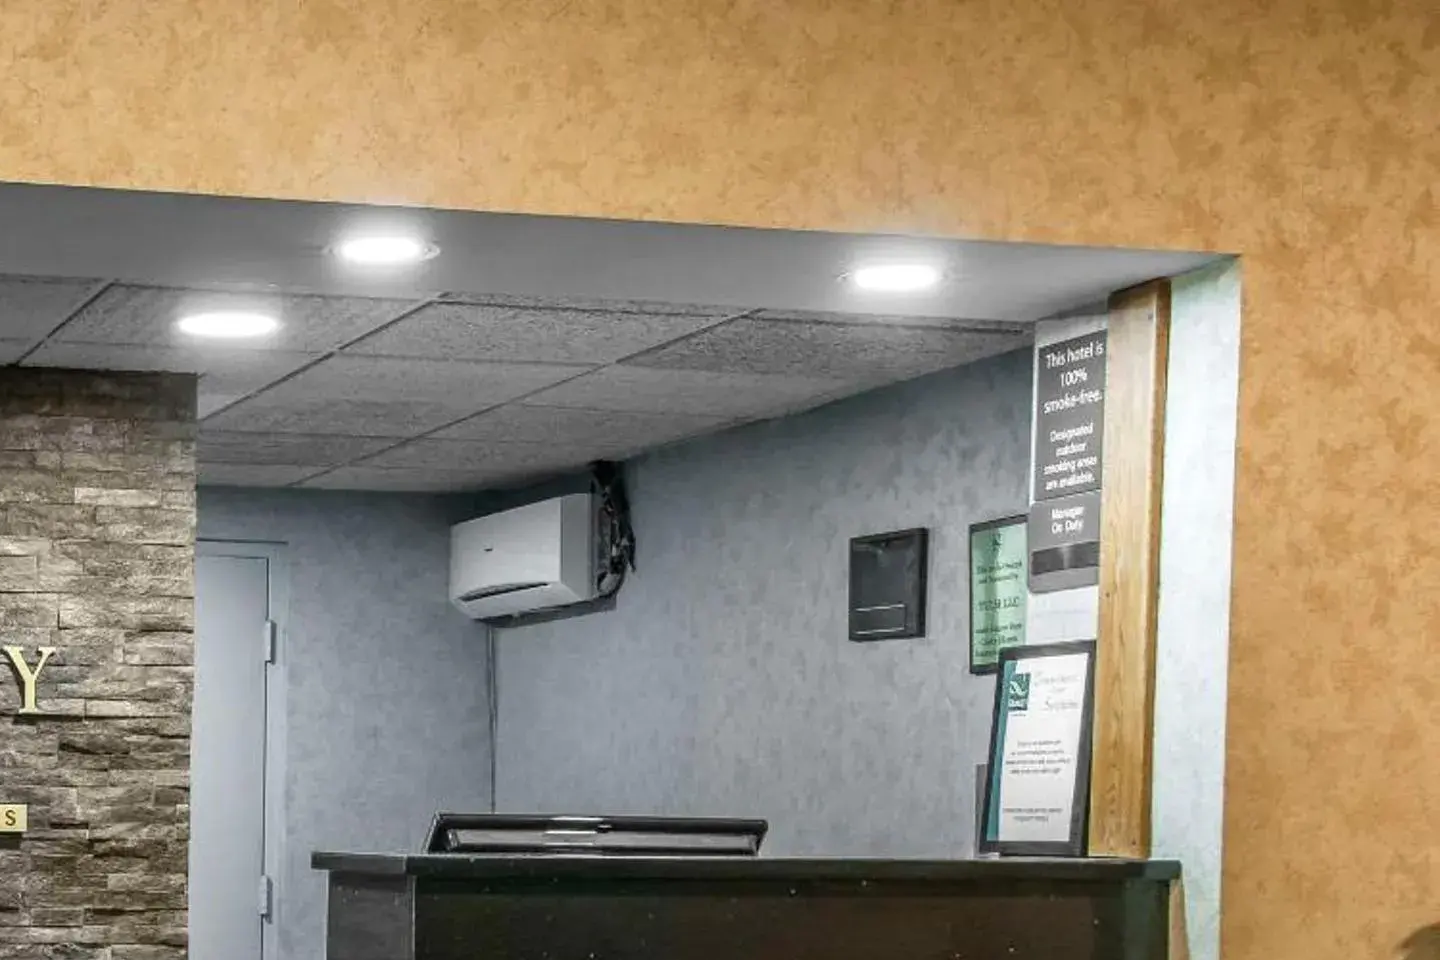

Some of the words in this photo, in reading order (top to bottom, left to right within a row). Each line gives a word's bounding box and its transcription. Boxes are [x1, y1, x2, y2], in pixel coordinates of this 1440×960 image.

[1046, 351, 1065, 369] This
[1067, 341, 1094, 362] hotel
[1060, 367, 1088, 388] 100%
[1049, 421, 1094, 442] Designated
[1044, 459, 1076, 475] smoking
[1076, 456, 1097, 468] areas
[1051, 521, 1063, 534] On
[1064, 519, 1084, 534] Duty
